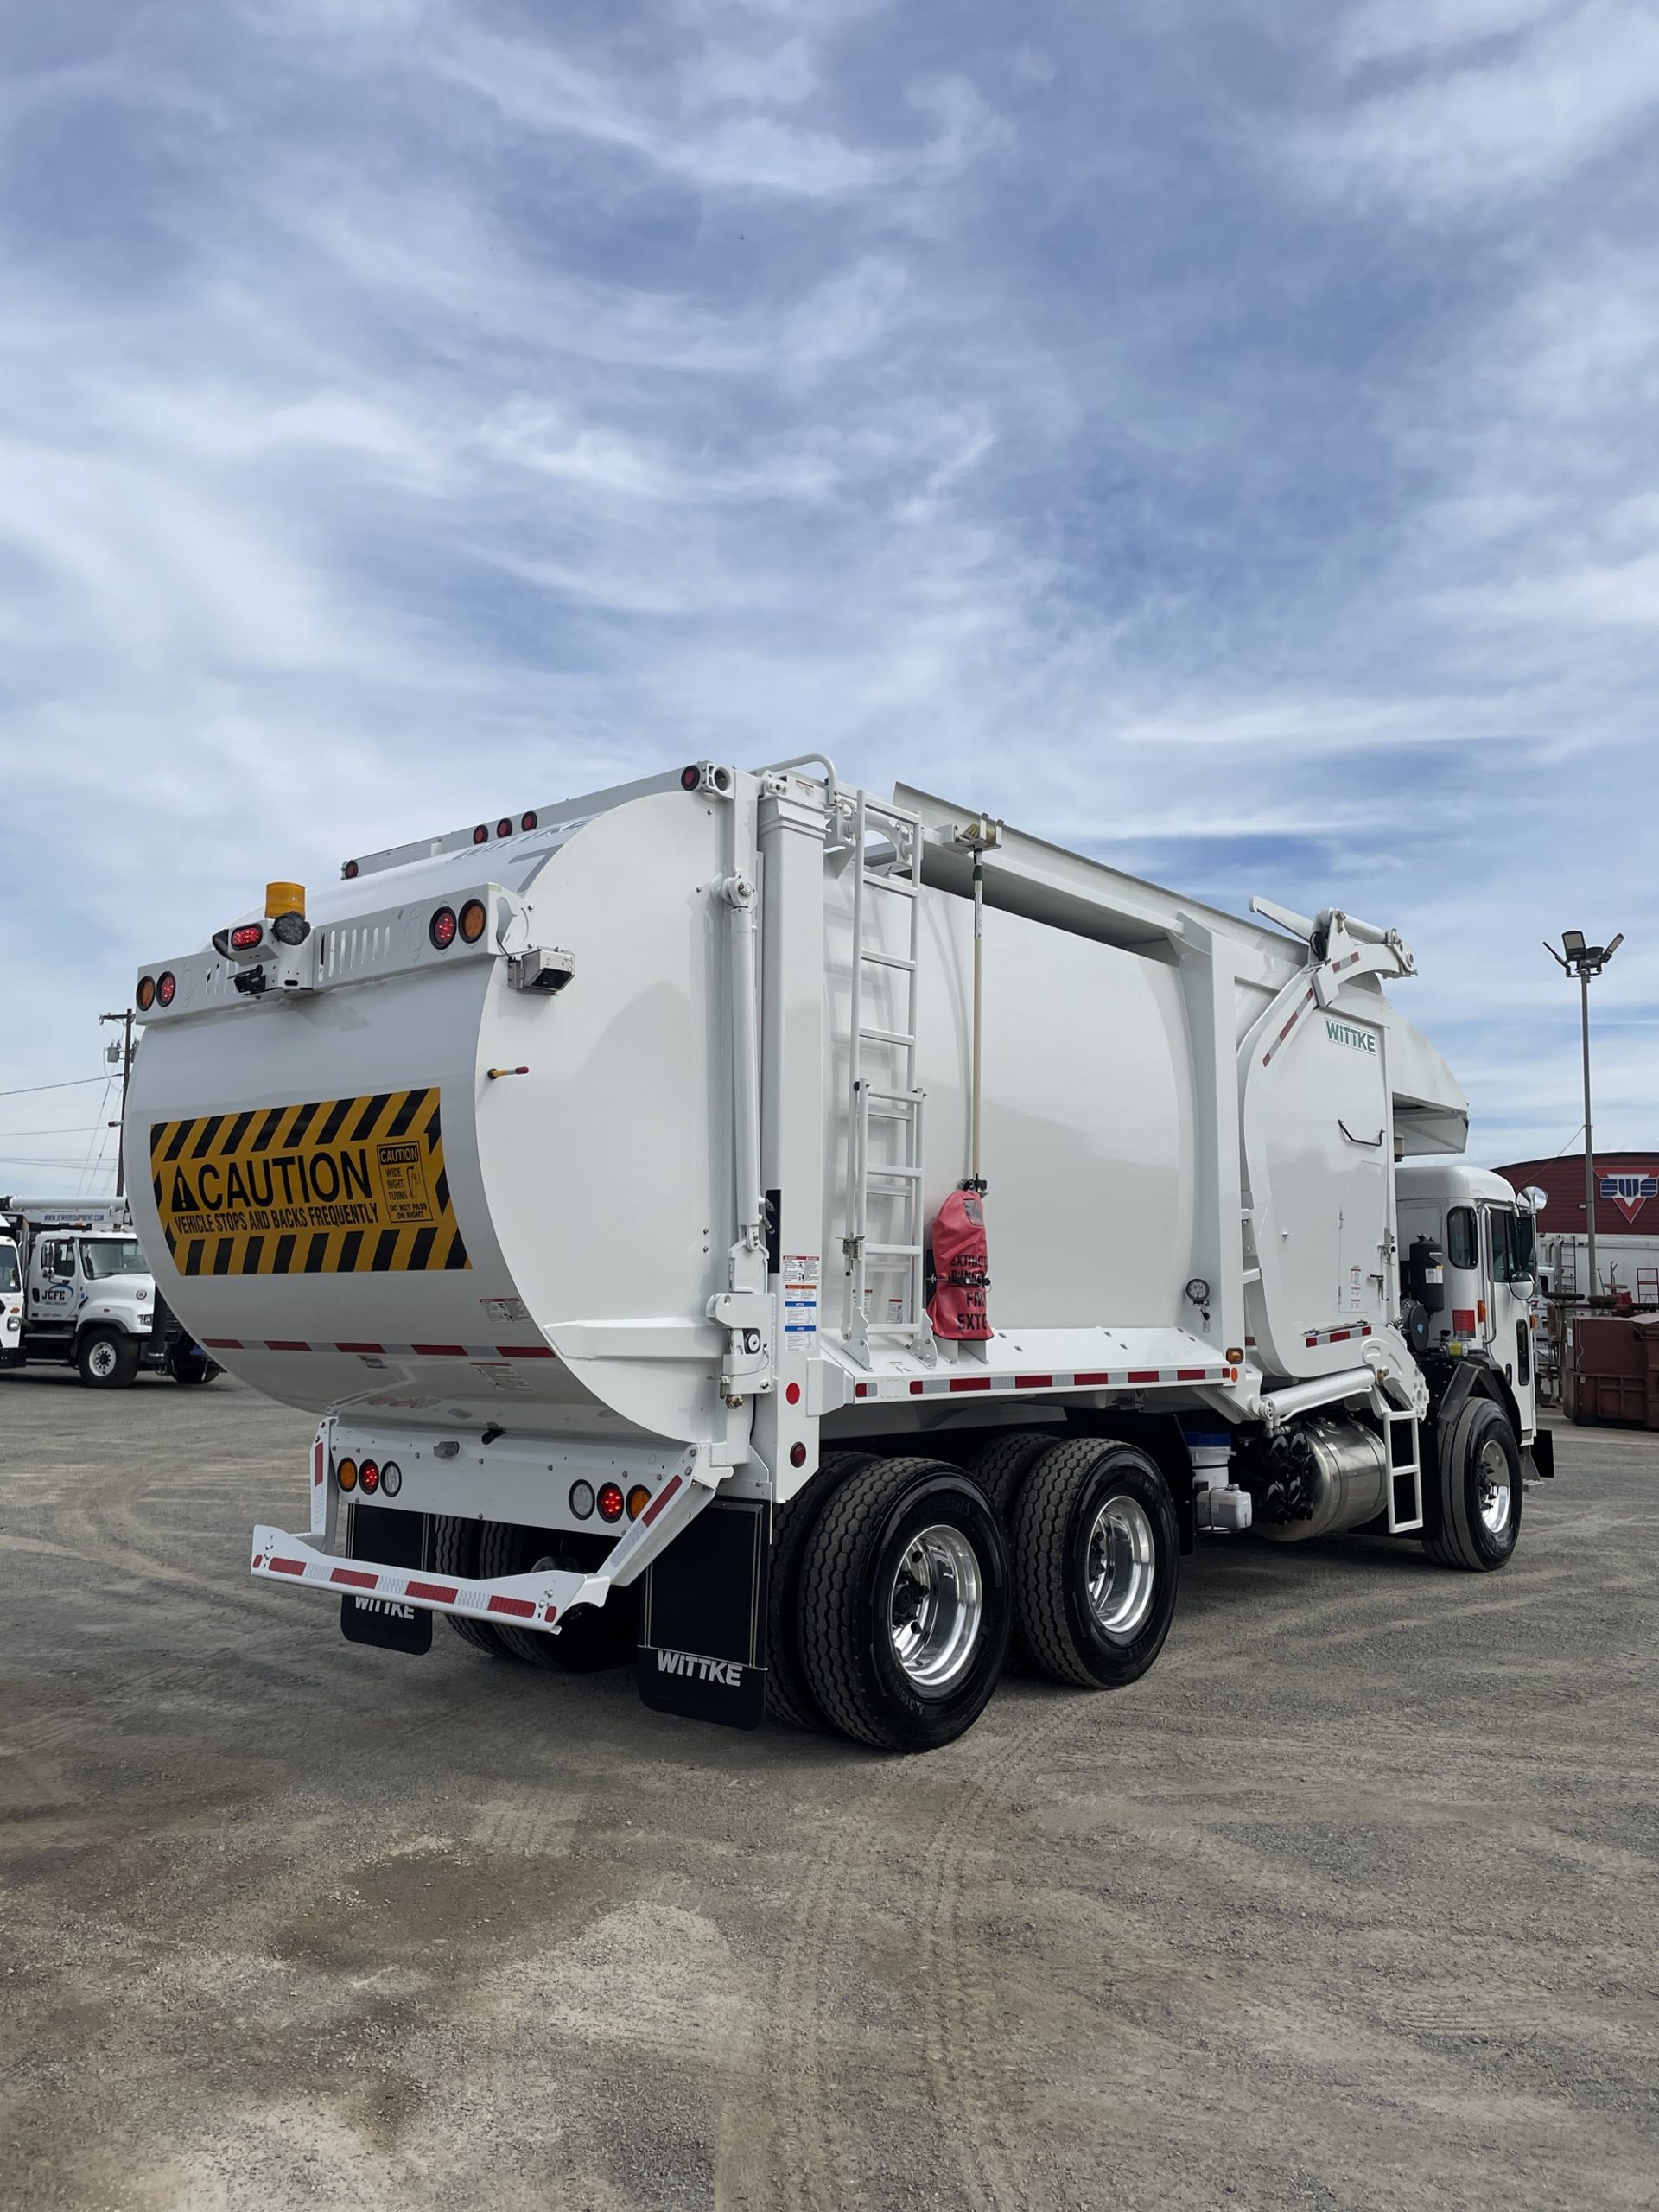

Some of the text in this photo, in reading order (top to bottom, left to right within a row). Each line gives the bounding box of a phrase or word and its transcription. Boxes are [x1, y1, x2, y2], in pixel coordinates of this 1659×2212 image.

[1325, 1020, 1376, 1053] WITTKE
[380, 1147, 418, 1163] CAUTION
[197, 1148, 373, 1211] CAUTION
[385, 1167, 402, 1178] WIDE
[386, 1179, 404, 1189] RIGHT
[388, 1191, 408, 1200] TURNS
[174, 1202, 379, 1235] VEHICLE STOPS AND BACKS FREQUENTLY
[658, 1649, 743, 1687] WITTKE
